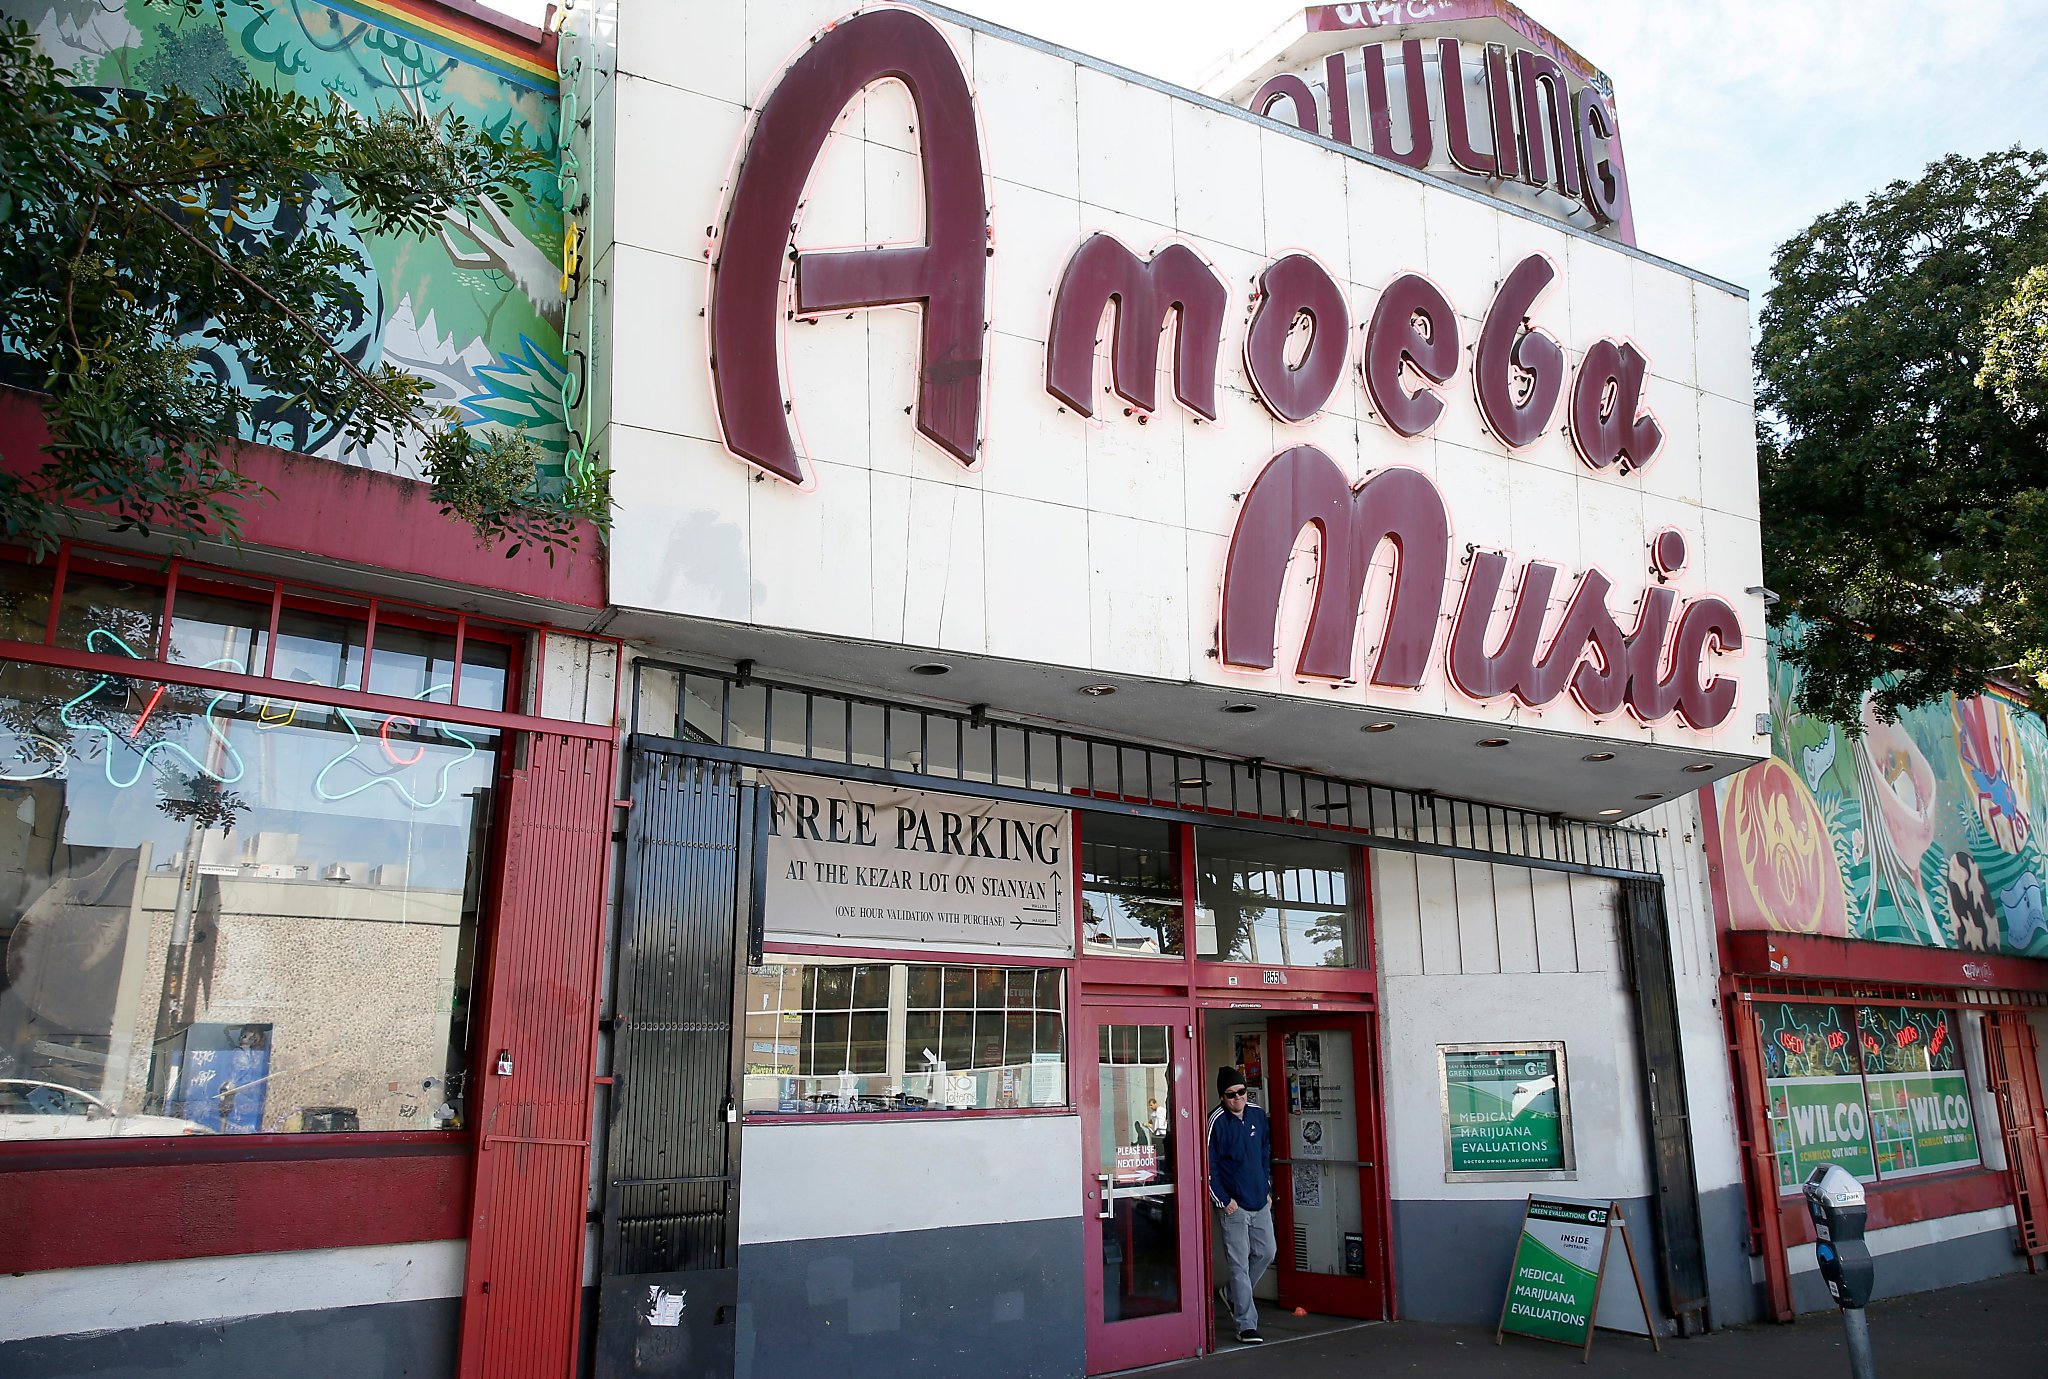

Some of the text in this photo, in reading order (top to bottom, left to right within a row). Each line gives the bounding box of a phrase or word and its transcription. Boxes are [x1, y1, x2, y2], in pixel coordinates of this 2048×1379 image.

[706, 6, 1666, 486] Amoeba
[1222, 444, 1744, 730] Music
[768, 790, 1061, 866] FREE PARKING
[785, 859, 1046, 900] AT THE KEZAR LOT ON STANYAN
[835, 904, 1005, 927] (ONE HOUR VALIDATION WITH PURCHASE)
[1263, 970, 1280, 984] 1855
[1780, 1031, 1803, 1055] USED
[1448, 1069, 1472, 1077] GREEN
[1473, 1068, 1522, 1077] EVALUATIONS
[945, 1076, 973, 1091] NO
[1459, 1111, 1515, 1123] MEDICAL
[1909, 1094, 1970, 1134] WILCO
[1791, 1102, 1866, 1146] WILCO
[1460, 1126, 1532, 1139] MARIJUANA
[1943, 1135, 1954, 1145] OUT
[1953, 1133, 1965, 1144] NOW
[1117, 1145, 1155, 1156] PLEASE USE
[1461, 1141, 1548, 1153] EVALUATIONS
[1831, 1147, 1844, 1158] OUT
[1843, 1146, 1858, 1157] NOW
[1117, 1157, 1155, 1169] NEXT DOOR
[1530, 1207, 1548, 1215] GREEN
[1548, 1209, 1586, 1220] EVALUATIONS
[1560, 1233, 1590, 1245] INSIDE
[1519, 1267, 1566, 1285] MEDICAL
[1515, 1284, 1576, 1305] MARIJUANA
[1511, 1303, 1586, 1327] EVALUATIONS
